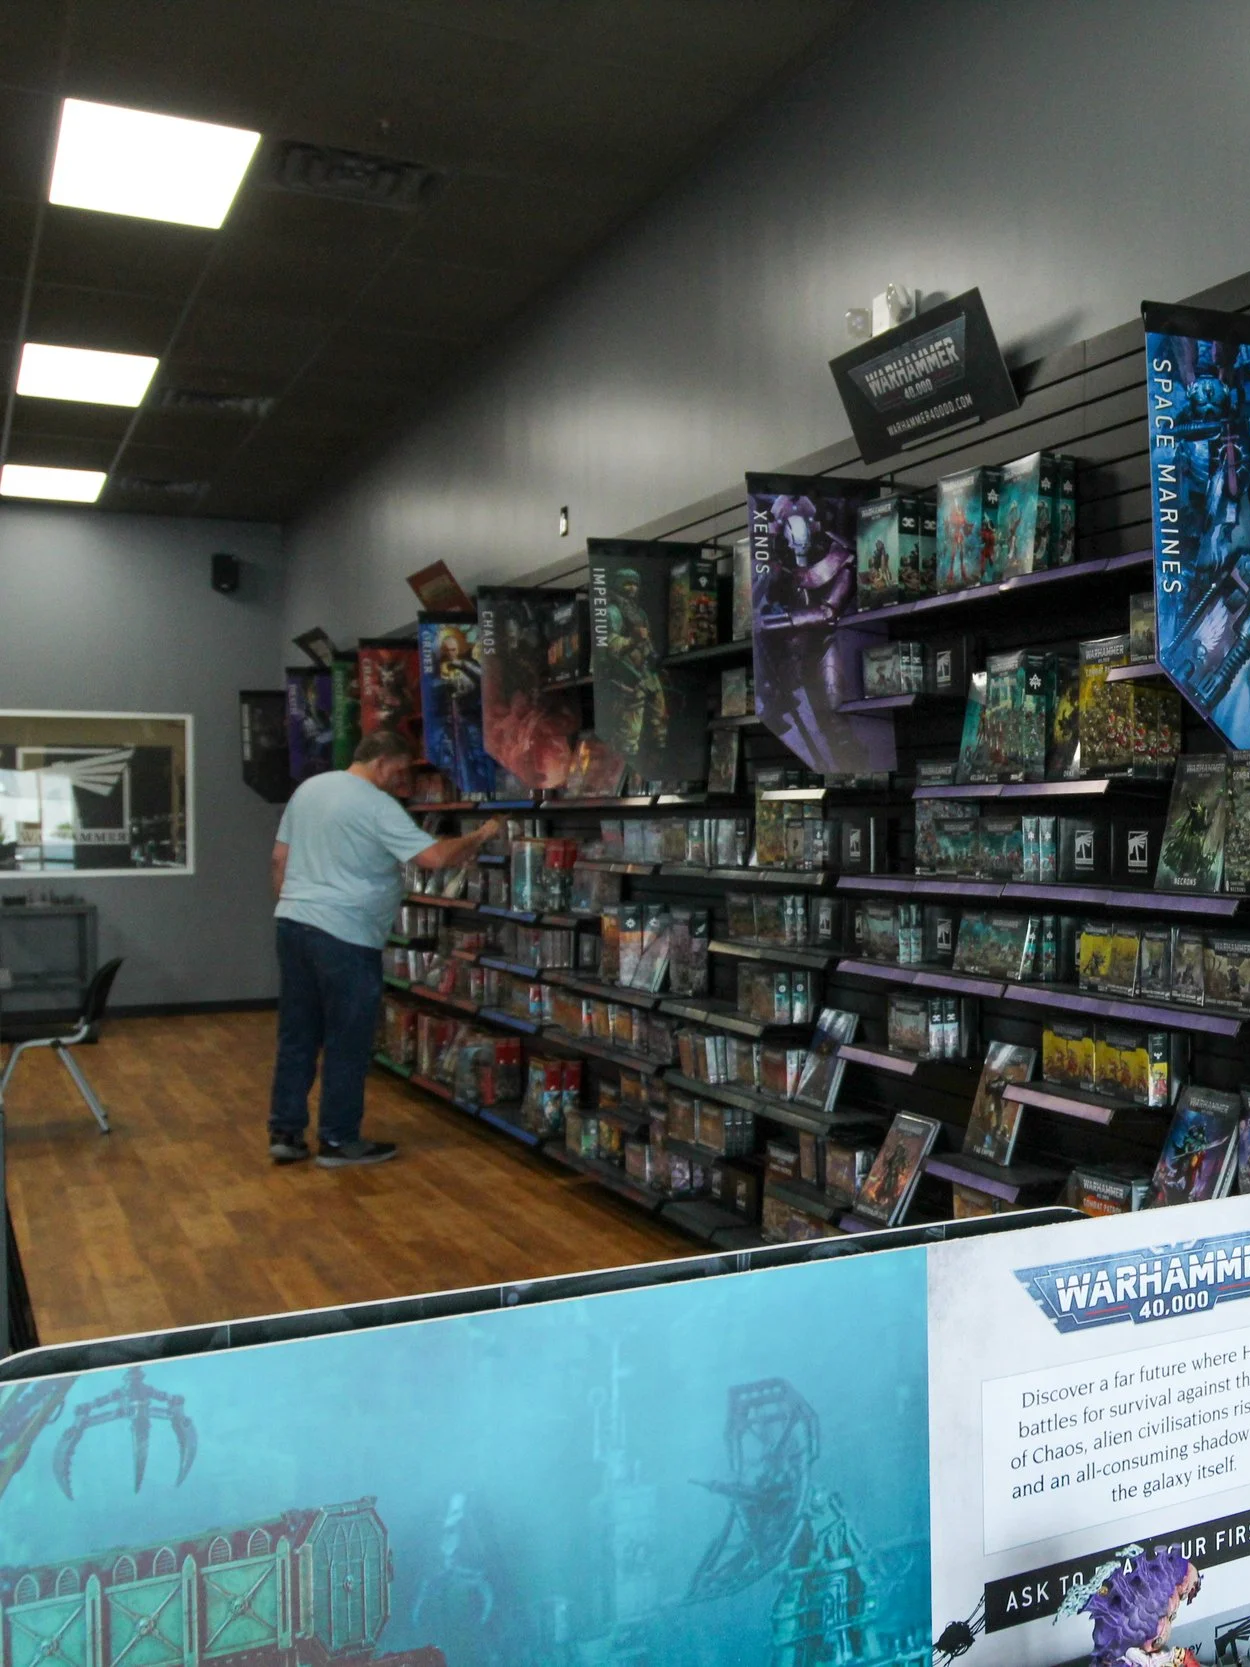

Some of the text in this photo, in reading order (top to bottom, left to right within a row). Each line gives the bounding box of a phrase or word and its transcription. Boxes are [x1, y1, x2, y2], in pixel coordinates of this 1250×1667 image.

[864, 336, 960, 398] WARHAMMER
[1152, 357, 1182, 596] SPACE MARINES
[753, 510, 770, 574] XENOS
[481, 611, 496, 656] CHAOS
[592, 567, 609, 648] IMPERIUM
[1083, 1179, 1125, 1200] WARHAMMER
[1139, 1290, 1209, 1321] 40,000
[1018, 1412, 1078, 1439] battles
[1083, 1406, 1105, 1425] for
[1109, 1388, 1172, 1420] survival
[1177, 1378, 1232, 1404] against
[1021, 1381, 1096, 1410] Discover
[1099, 1378, 1109, 1392] a
[1114, 1369, 1135, 1389] far
[1140, 1361, 1187, 1384] future
[1191, 1350, 1238, 1371] where
[1010, 1453, 1028, 1471] of
[1032, 1440, 1088, 1465] Chaos,
[1093, 1428, 1134, 1451] alien
[1138, 1407, 1229, 1439] civilisations
[1011, 1475, 1045, 1499] and
[1050, 1474, 1071, 1491] an
[1076, 1443, 1189, 1484] all-consuming
[1192, 1428, 1249, 1454] shadow
[1111, 1455, 1237, 1503] the galaxy itself.
[1006, 1581, 1050, 1612] ASK
[1059, 1571, 1084, 1596] TO
